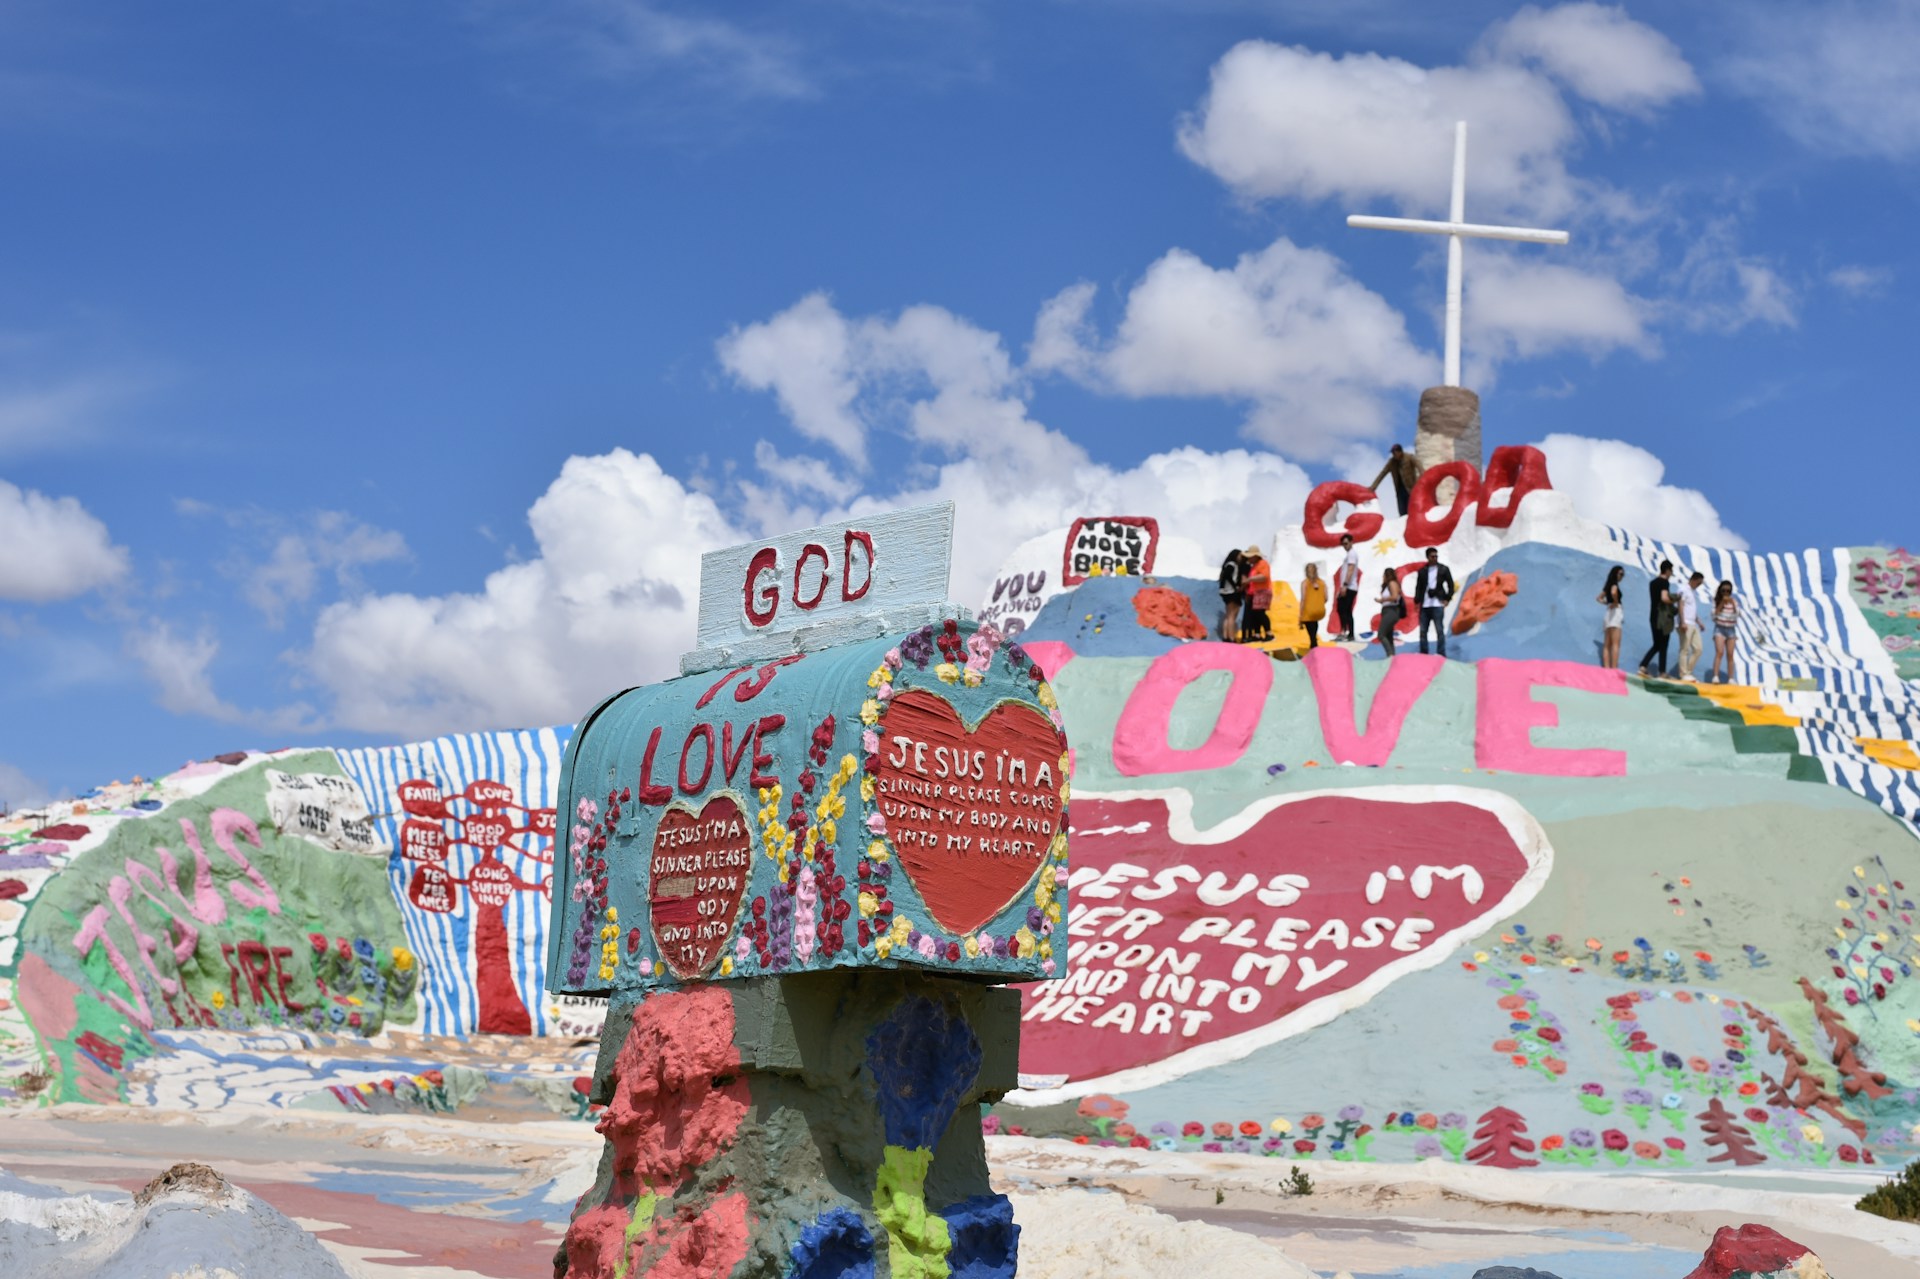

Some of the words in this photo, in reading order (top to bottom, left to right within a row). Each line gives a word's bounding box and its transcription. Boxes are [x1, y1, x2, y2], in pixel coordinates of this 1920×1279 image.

[1303, 445, 1553, 548] GOD
[1077, 534, 1143, 558] HOLY
[744, 529, 875, 628] GOD
[992, 569, 1047, 603] YOU
[1023, 640, 1629, 777] OVE
[639, 714, 786, 807] LOVE
[888, 735, 986, 782] JESUS
[1033, 761, 1054, 789] A
[404, 786, 442, 803] FAITH
[474, 786, 512, 802] LOVE
[879, 778, 943, 799] SINNER
[948, 784, 1001, 804] PLEASE
[1008, 790, 1054, 810] COME
[466, 821, 506, 837] GOOD
[884, 801, 932, 820] UPON
[937, 807, 965, 826] MY
[969, 809, 1009, 829] BODY
[1011, 815, 1051, 835] AND
[468, 833, 500, 847] NESS
[659, 824, 701, 848] JESUS
[727, 820, 741, 839] A
[896, 829, 938, 847] INTO
[946, 833, 972, 851] MY
[406, 844, 442, 862] NESS
[653, 854, 702, 875] SINNER
[704, 847, 748, 869] PLEASE
[471, 880, 513, 895] SUFFER
[475, 867, 510, 881] LONG
[697, 875, 737, 892] UPON
[1365, 865, 1484, 905] I'M
[478, 893, 504, 907] ING
[697, 920, 728, 940] INTO
[1178, 915, 1436, 952] PLEASE
[1231, 952, 1348, 993] MY
[1031, 965, 1128, 998] AND
[1139, 973, 1262, 1014] INTO
[1022, 995, 1213, 1038] HEART
